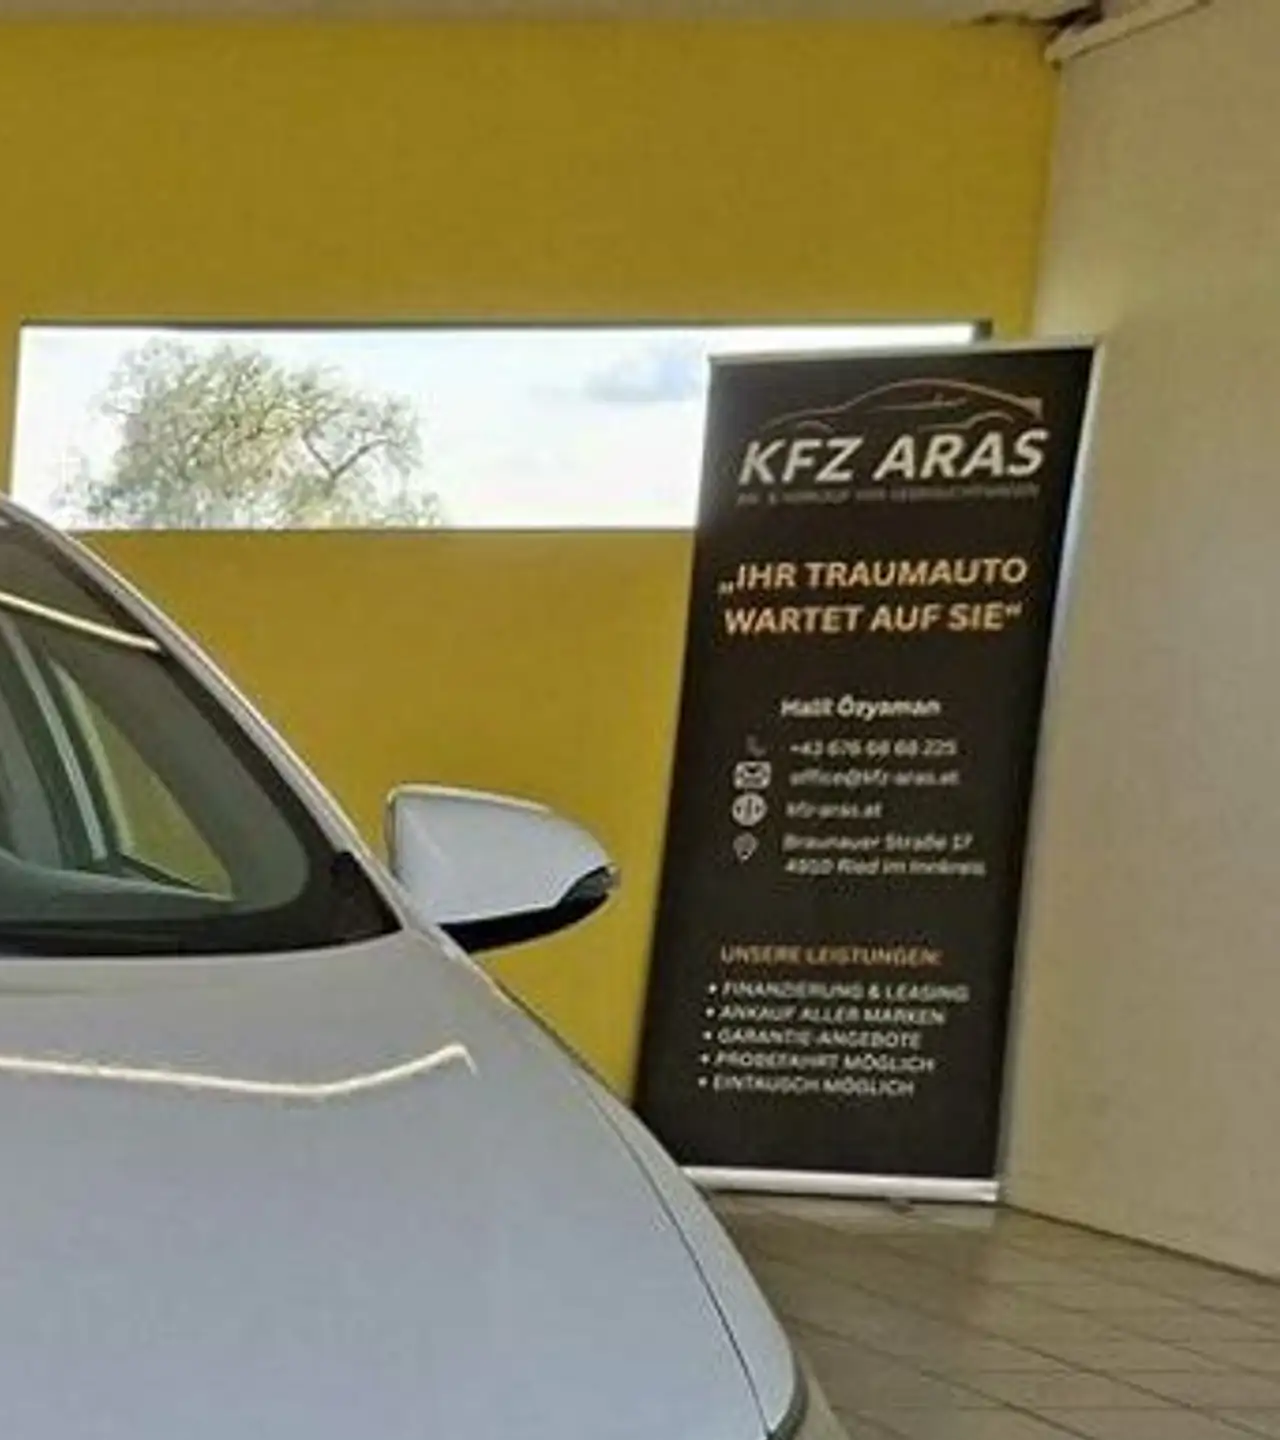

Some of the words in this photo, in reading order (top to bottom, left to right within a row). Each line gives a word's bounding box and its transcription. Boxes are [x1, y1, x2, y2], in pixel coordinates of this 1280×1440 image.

[740, 438, 864, 485] KFZ
[871, 428, 1049, 482] ARAS
[805, 557, 1029, 591] TRAUMAUTO
[724, 606, 864, 634] WARTET
[869, 604, 941, 632] AUF
[720, 945, 801, 966] UNSERE
[721, 981, 865, 1001] FINANZIERUNG
[718, 1004, 797, 1023] ANKAUF
[799, 1005, 860, 1024] ALLER
[863, 1007, 946, 1026] MARKEN
[843, 1052, 935, 1073] MÖGLICH
[822, 1074, 914, 1097] MÖGLICH
